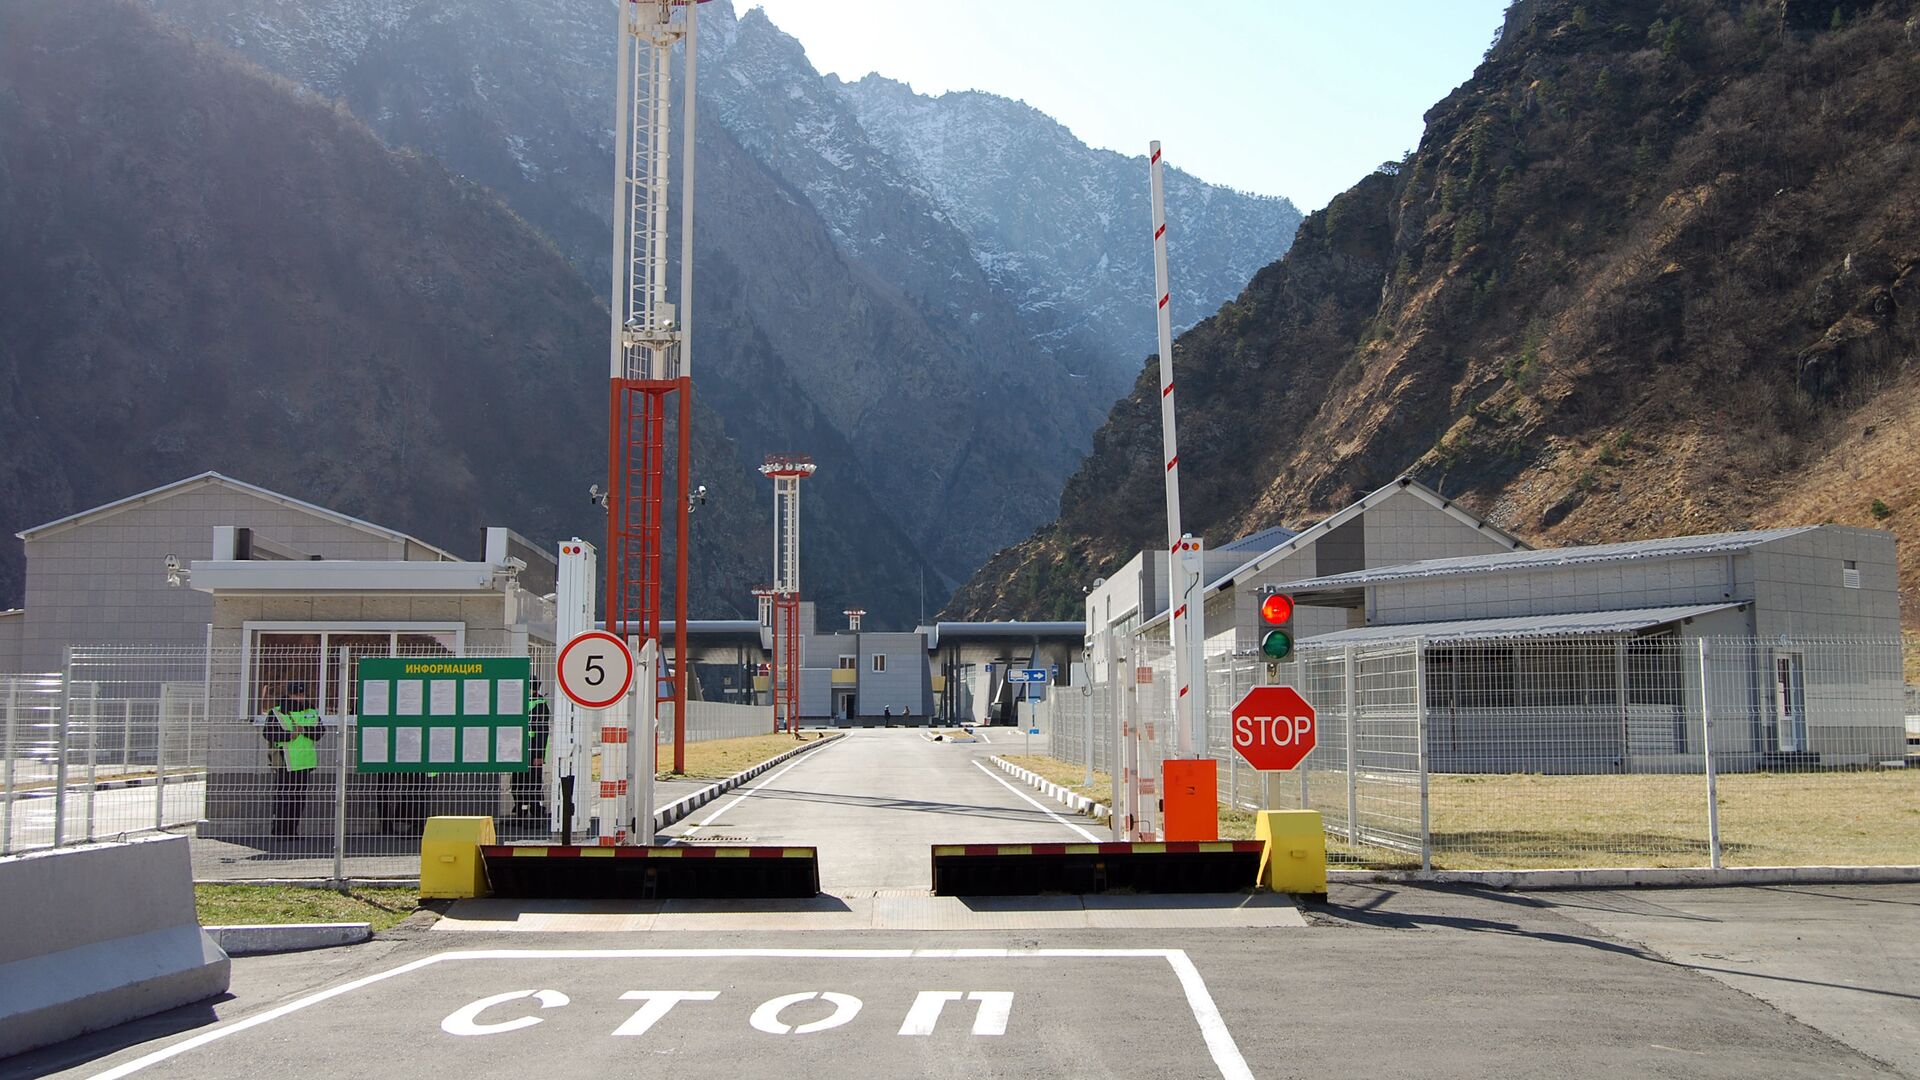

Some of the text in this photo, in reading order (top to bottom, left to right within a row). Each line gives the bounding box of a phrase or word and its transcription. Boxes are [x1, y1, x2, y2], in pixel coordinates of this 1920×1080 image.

[405, 663, 483, 674] ИНФОРМАЦИЯ
[584, 655, 605, 685] 5
[1236, 716, 1311, 746] STOP
[441, 989, 1014, 1036] СТОП
